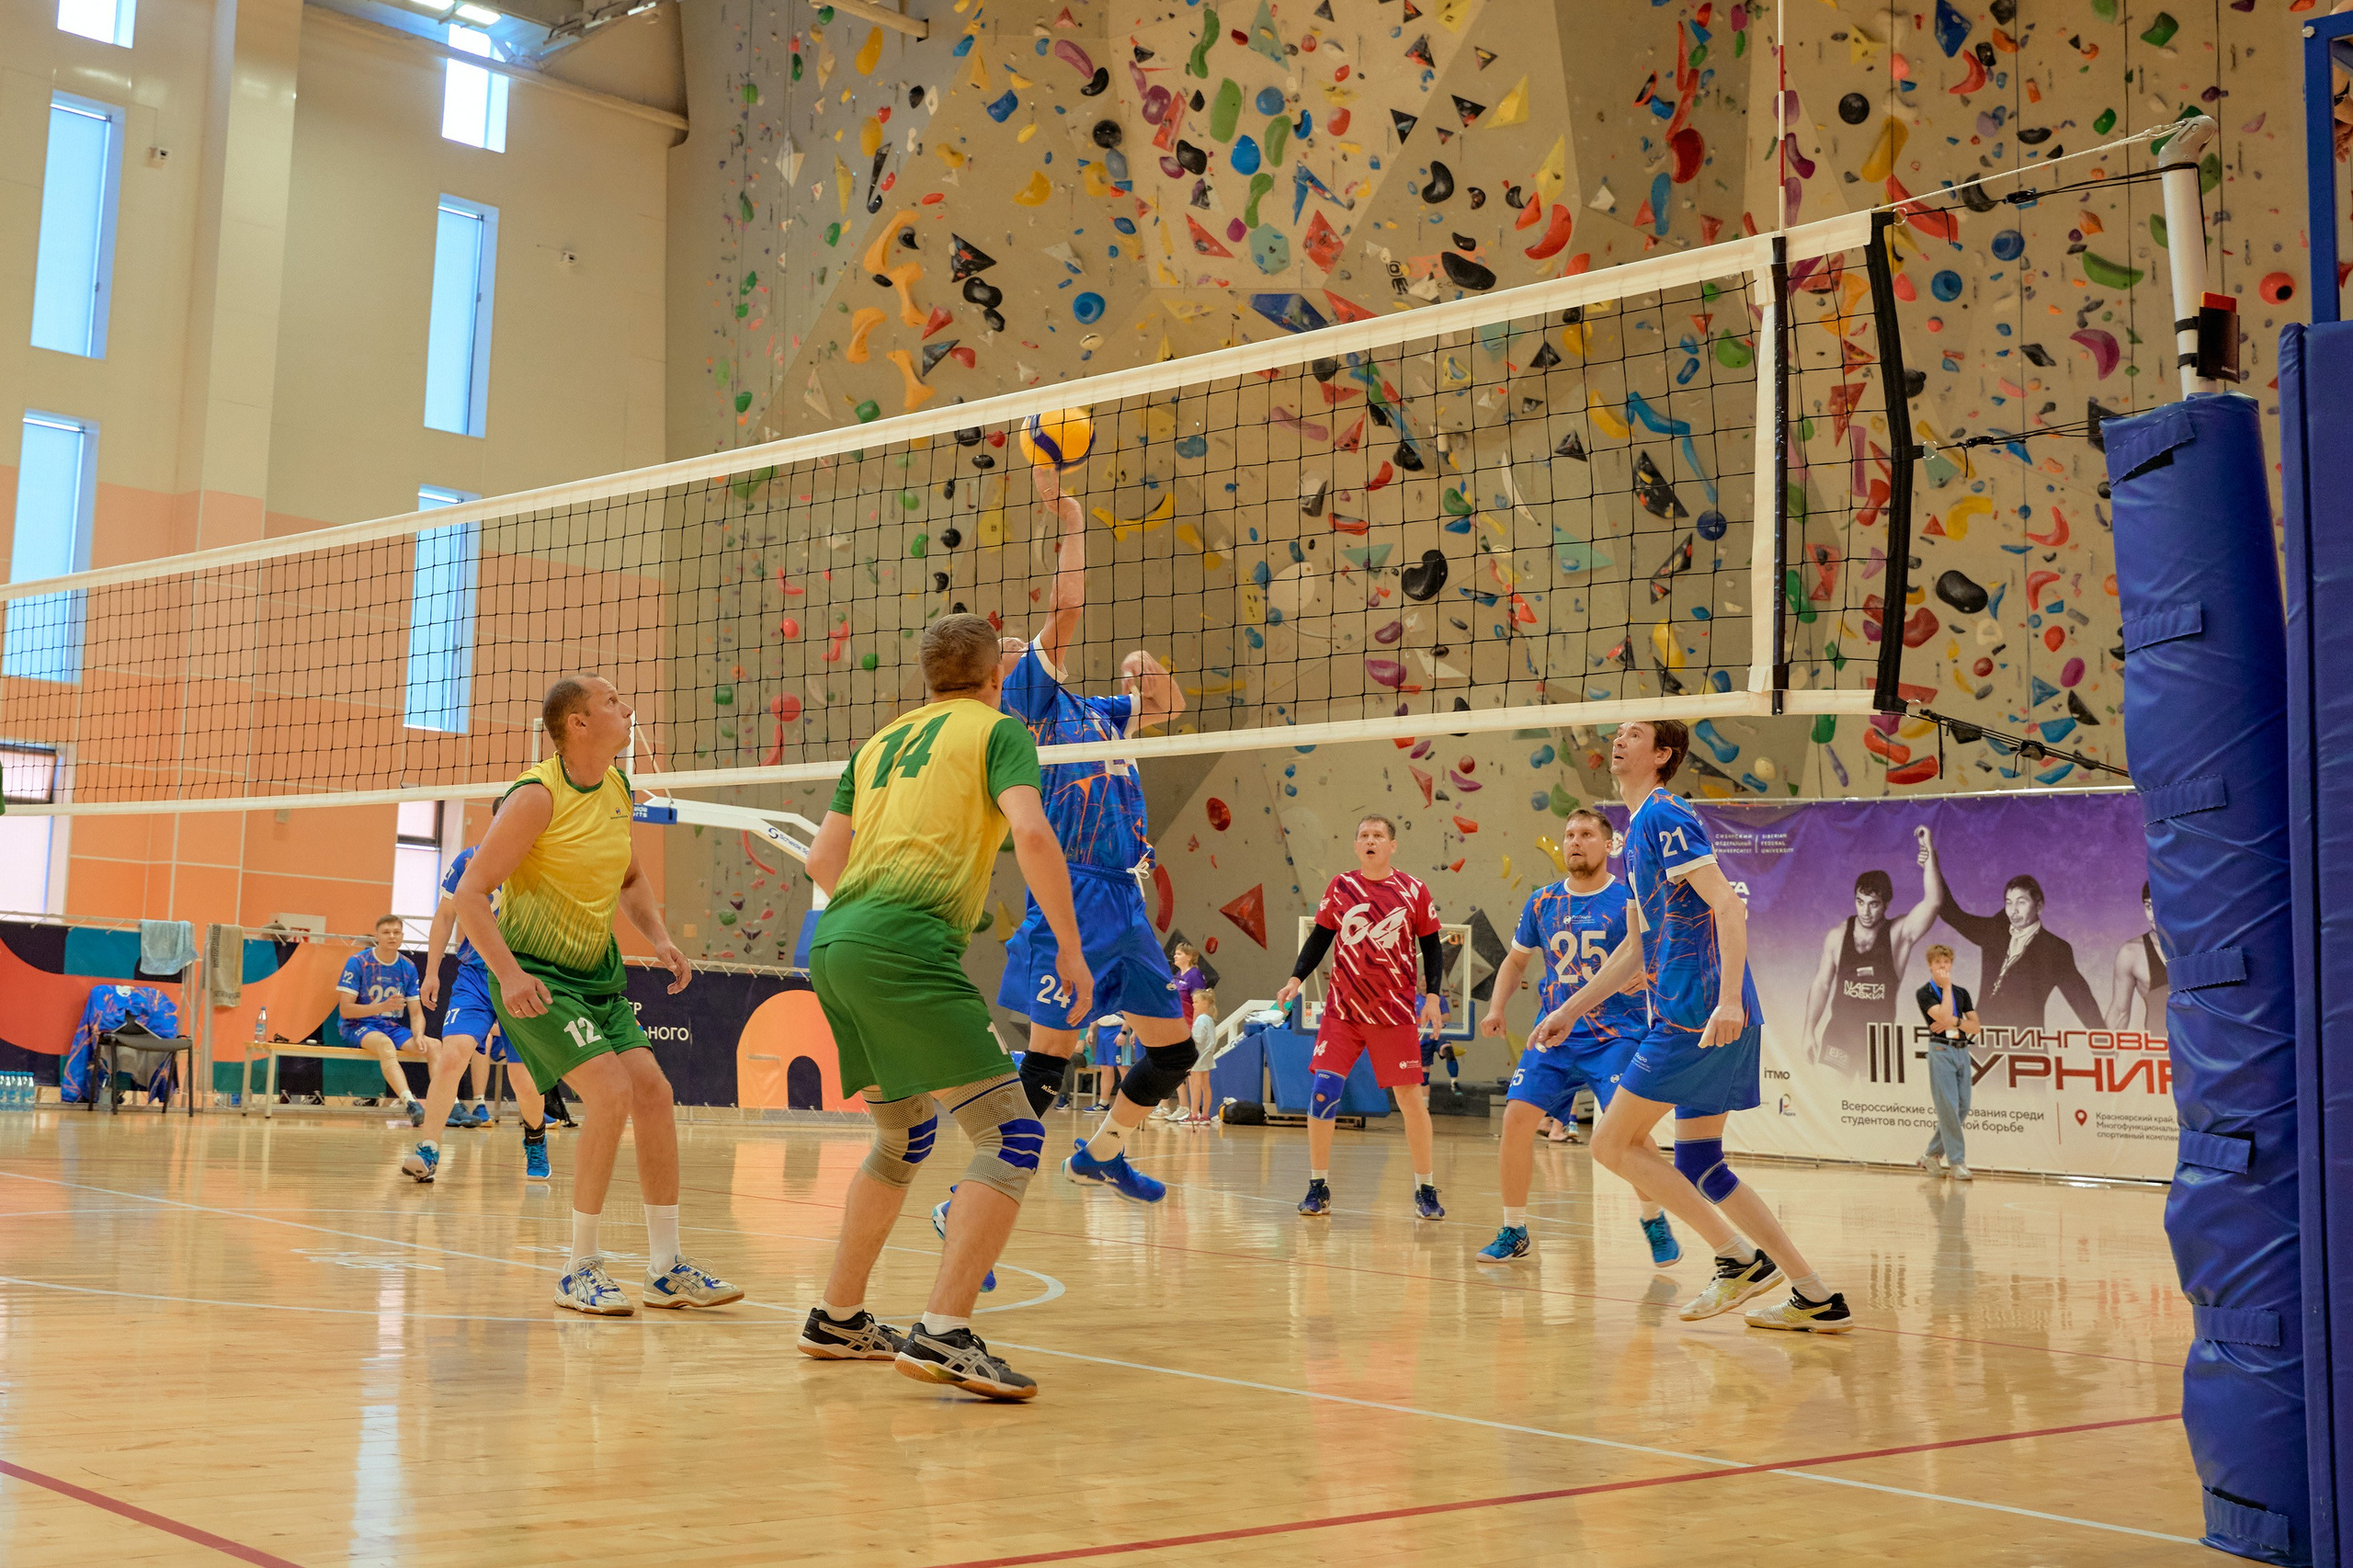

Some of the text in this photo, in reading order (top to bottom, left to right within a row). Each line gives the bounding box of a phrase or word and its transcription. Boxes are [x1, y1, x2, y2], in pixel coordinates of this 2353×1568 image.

[870, 711, 952, 790] 14
[1659, 825, 1688, 858] 21
[1340, 903, 1408, 949] 64
[1550, 930, 1608, 983] 25
[1036, 974, 1071, 1009] 24
[443, 1007, 460, 1027] 27
[563, 1017, 602, 1048] 12
[1841, 1100, 2044, 1120] Всероссийские соования среди
[2096, 1112, 2153, 1122] Красноярский
[1841, 1115, 2024, 1134] студентов по спорной борьбе
[2097, 1121, 2179, 1132] Многофункциональн
[2097, 1131, 2144, 1140] спортивный
